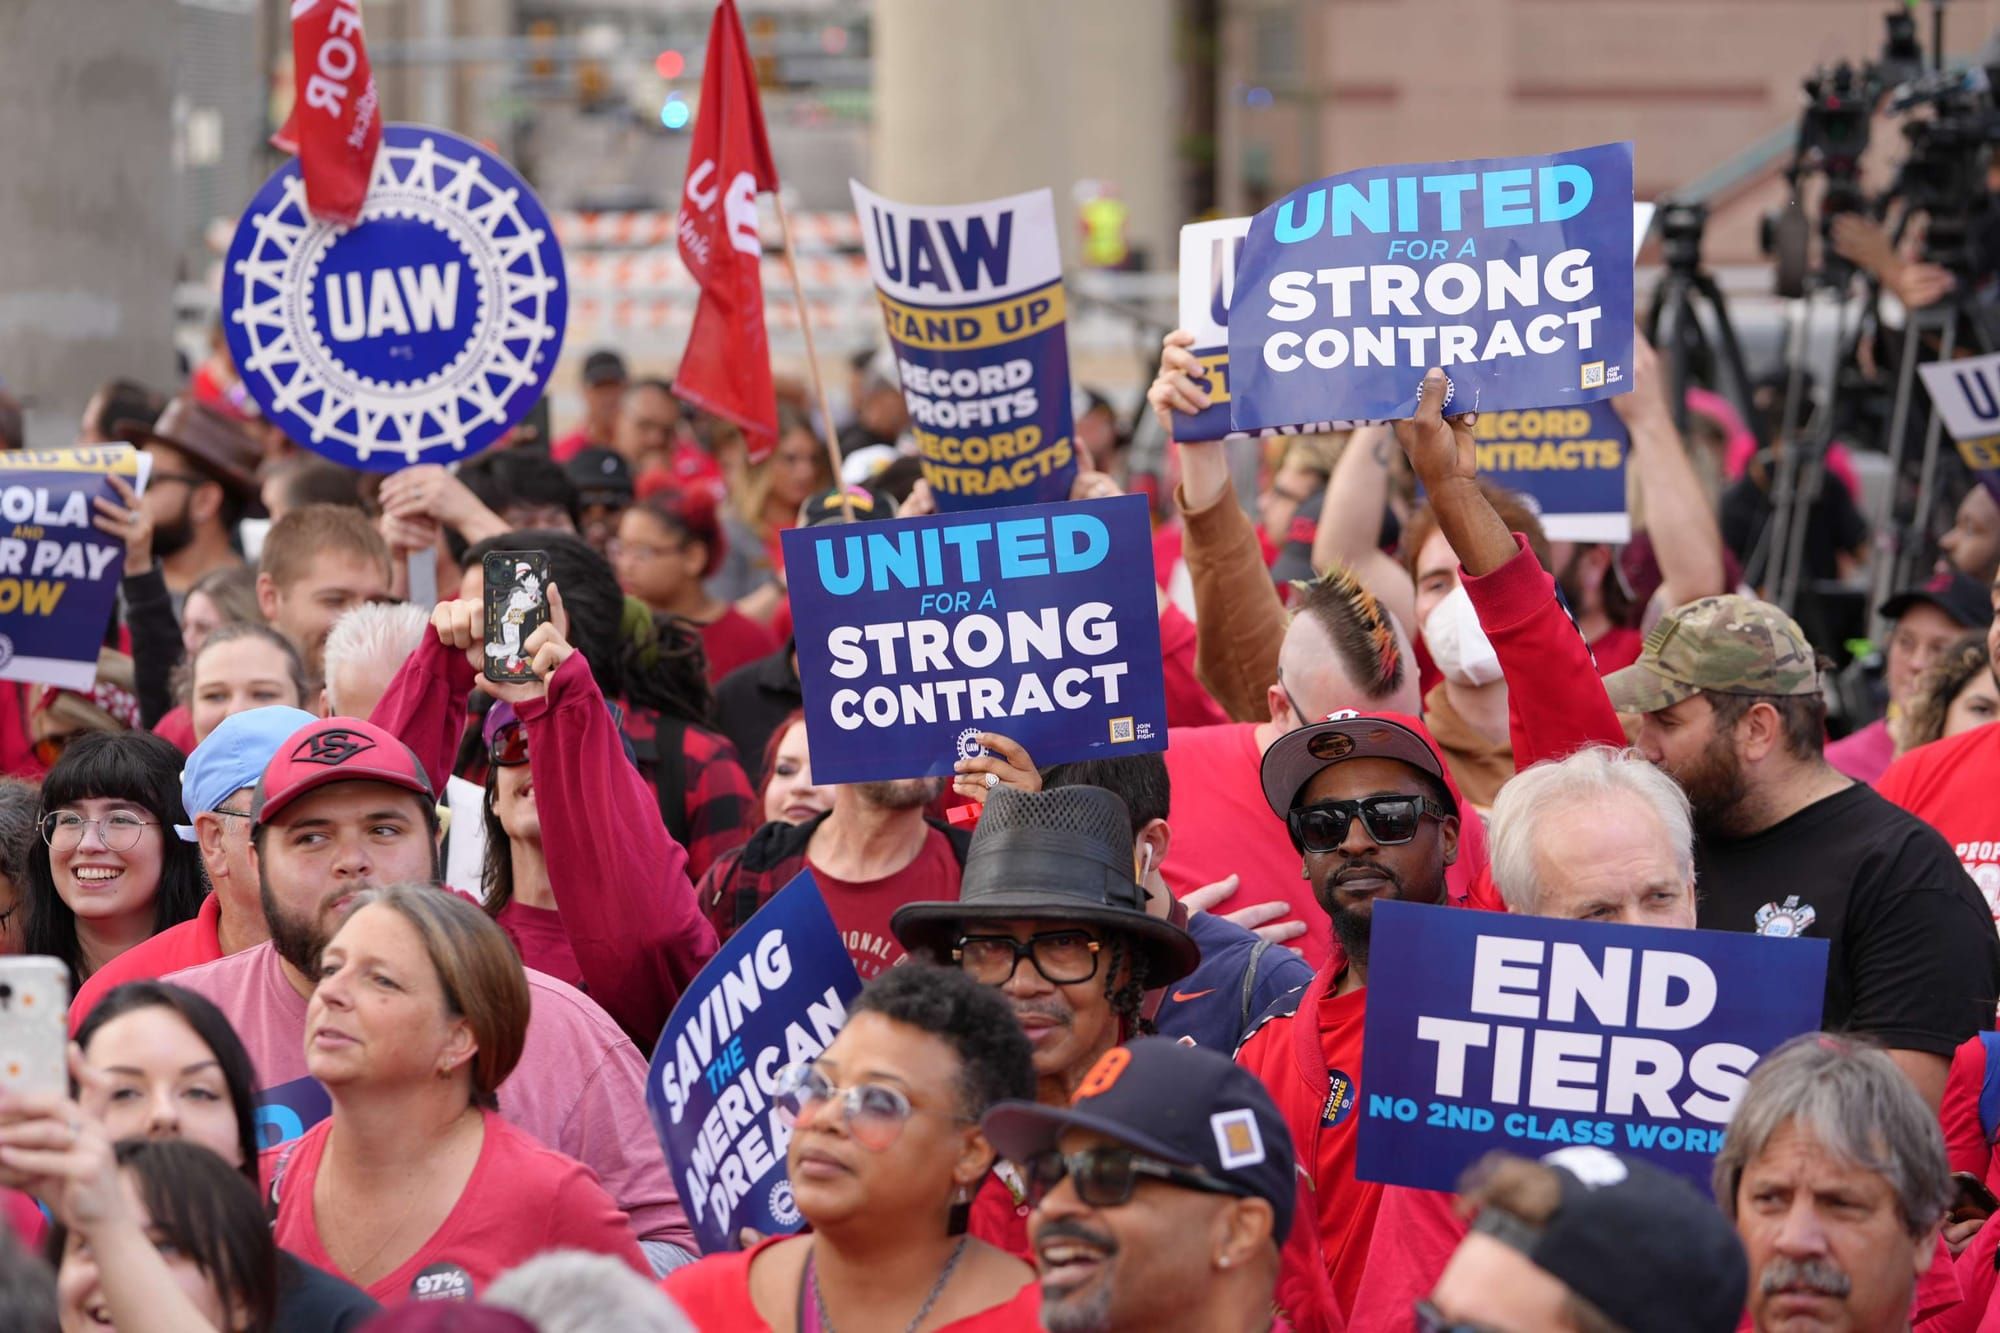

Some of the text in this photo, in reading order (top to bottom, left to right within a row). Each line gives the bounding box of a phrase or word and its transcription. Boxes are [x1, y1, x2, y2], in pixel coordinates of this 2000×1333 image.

[1274, 164, 1593, 244] UNITED
[872, 206, 1013, 293] UAW
[1387, 237, 1477, 261] FOR A
[325, 262, 461, 342] UAW
[1266, 248, 1594, 322] STRONG
[997, 300, 1050, 334] UP
[1263, 307, 1602, 372] CONTRACT
[1474, 410, 1592, 440] ECORD
[1476, 439, 1623, 471] NTRACTS
[920, 436, 1072, 495] NTRACTS
[0, 485, 88, 528] OLA
[31, 540, 120, 581] PAY
[815, 513, 1110, 596] UNITED
[920, 589, 997, 615] FOR A
[827, 602, 1118, 679] STRONG
[830, 662, 1128, 730] CONTRACT
[1471, 935, 1718, 1031] END
[662, 929, 792, 1125] SAVING
[706, 1035, 746, 1095] THE
[1417, 1016, 1760, 1124] TIERS
[685, 986, 851, 1224] AMERICAN
[1322, 1078, 1341, 1119] READY TO
[1327, 1079, 1347, 1121] STRIKE
[1368, 1094, 1418, 1123] NO
[1426, 1102, 1495, 1132] 2ND
[1504, 1113, 1615, 1145] CLASS
[416, 1270, 464, 1294] 97%
